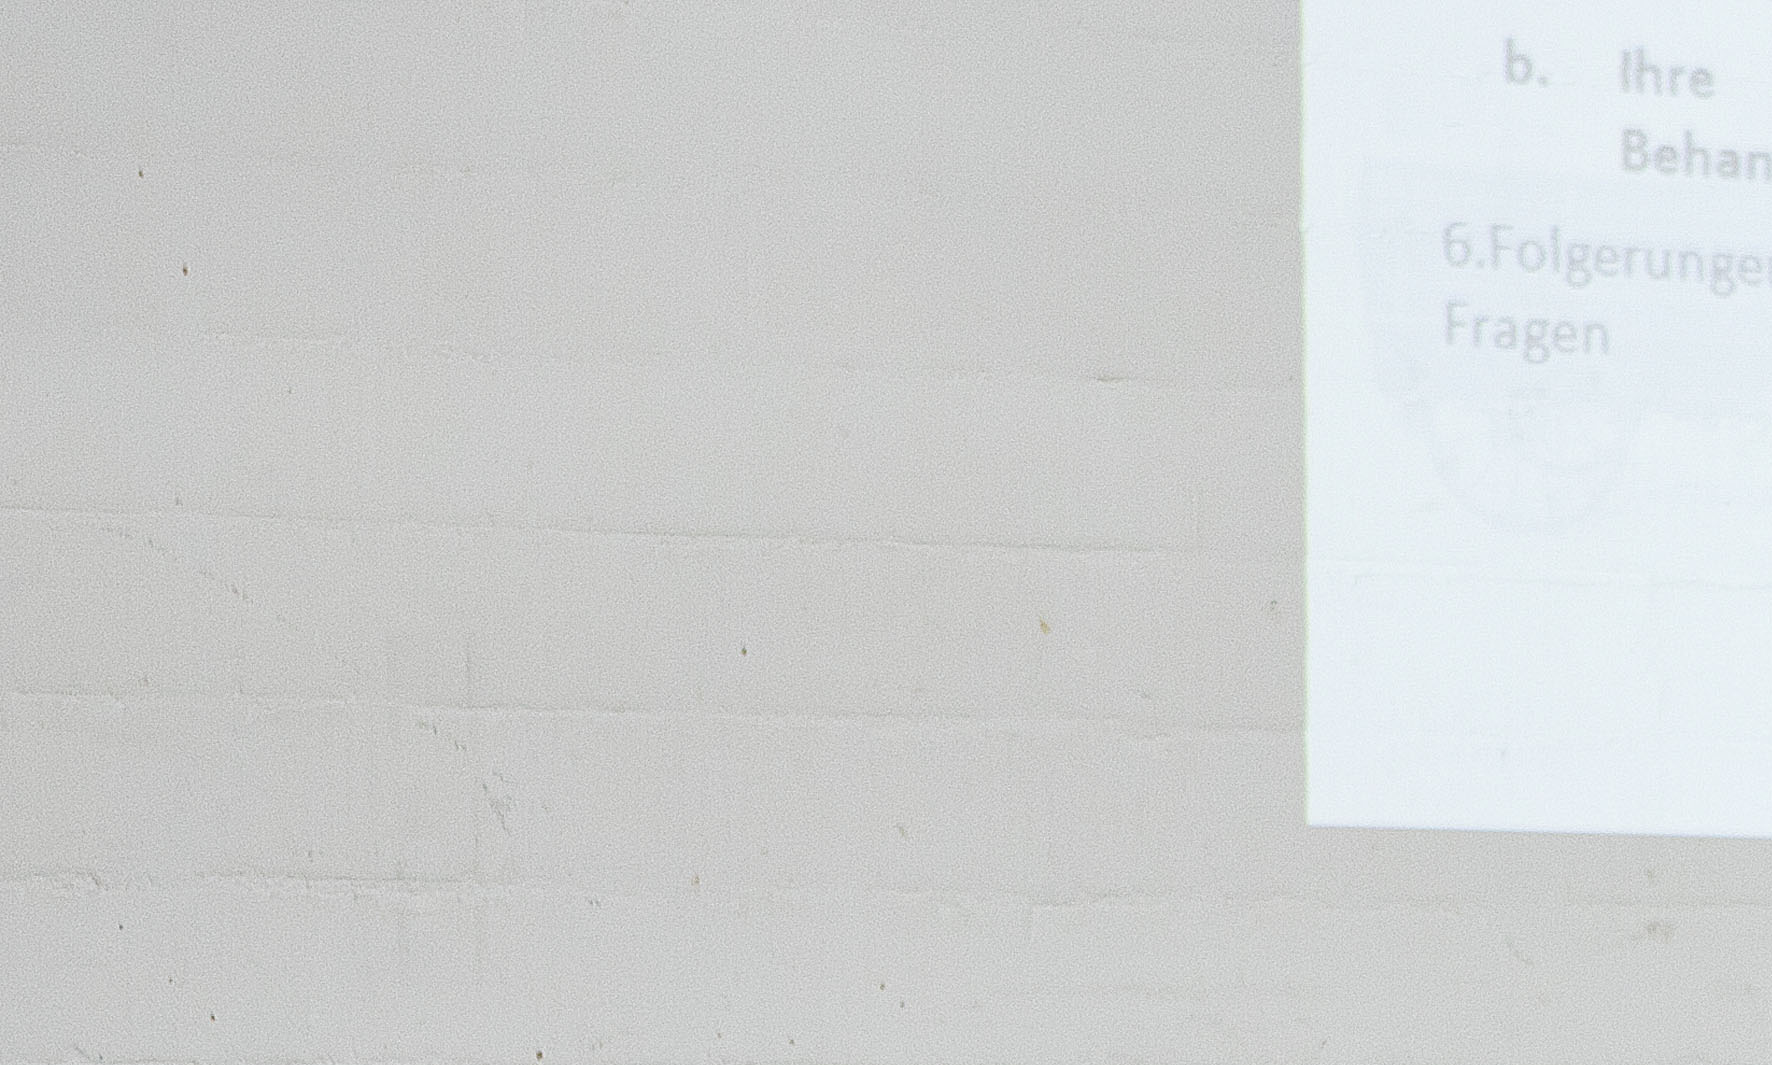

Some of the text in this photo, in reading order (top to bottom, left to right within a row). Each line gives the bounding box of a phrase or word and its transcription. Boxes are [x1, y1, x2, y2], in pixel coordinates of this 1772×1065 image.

[1502, 36, 1717, 98] b. Ihre
[1442, 300, 1611, 364] Fragen
